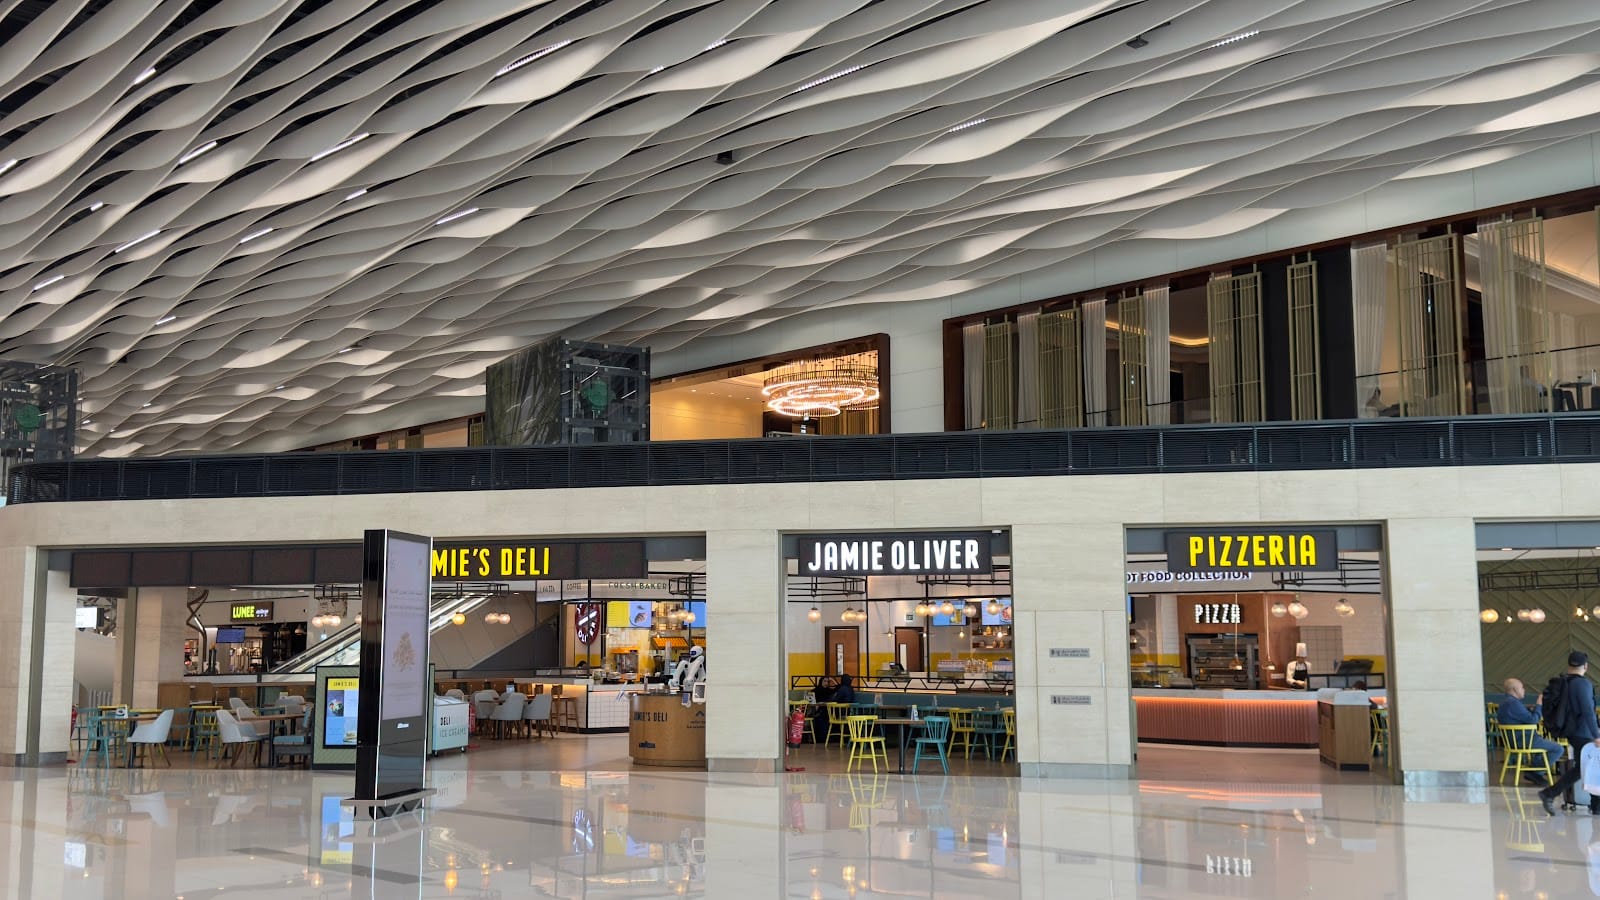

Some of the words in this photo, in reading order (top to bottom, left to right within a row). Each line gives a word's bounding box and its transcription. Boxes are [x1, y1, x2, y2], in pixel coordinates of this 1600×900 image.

[807, 540, 884, 571] JAMIE
[891, 538, 980, 570] OLIVER
[1189, 534, 1317, 567] PIZZERIA
[432, 548, 490, 577] MIE'S
[500, 547, 550, 576] DELI
[1126, 572, 1139, 583] OT
[1140, 571, 1172, 583] FOOD
[1175, 569, 1251, 582] COLLECTION
[608, 581, 637, 590] FRESH
[1194, 603, 1242, 624] PIZZA
[440, 715, 451, 726] DELI
[653, 711, 668, 722] DELI
